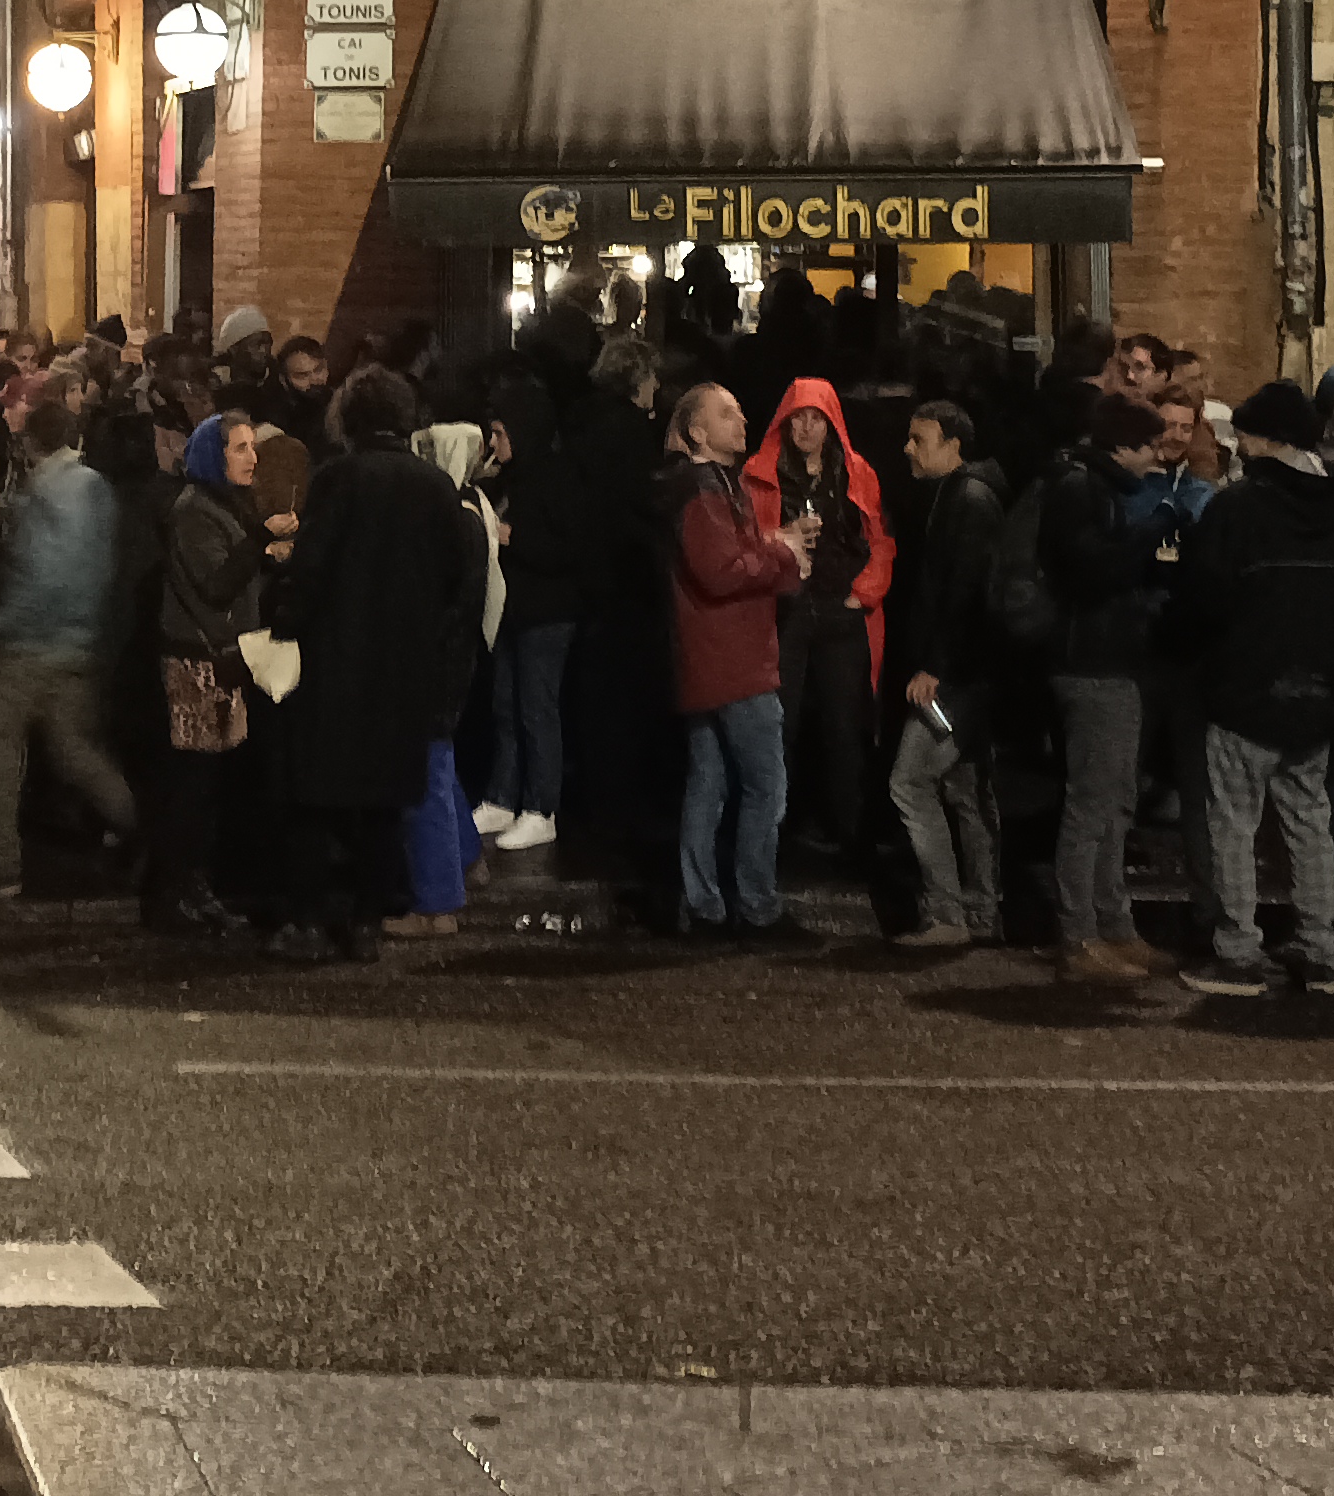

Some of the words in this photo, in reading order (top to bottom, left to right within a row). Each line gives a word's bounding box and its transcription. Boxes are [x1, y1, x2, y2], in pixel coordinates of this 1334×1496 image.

[316, 4, 385, 20] TOUNIS
[337, 37, 363, 49] CAI
[685, 185, 989, 239] Filochard
